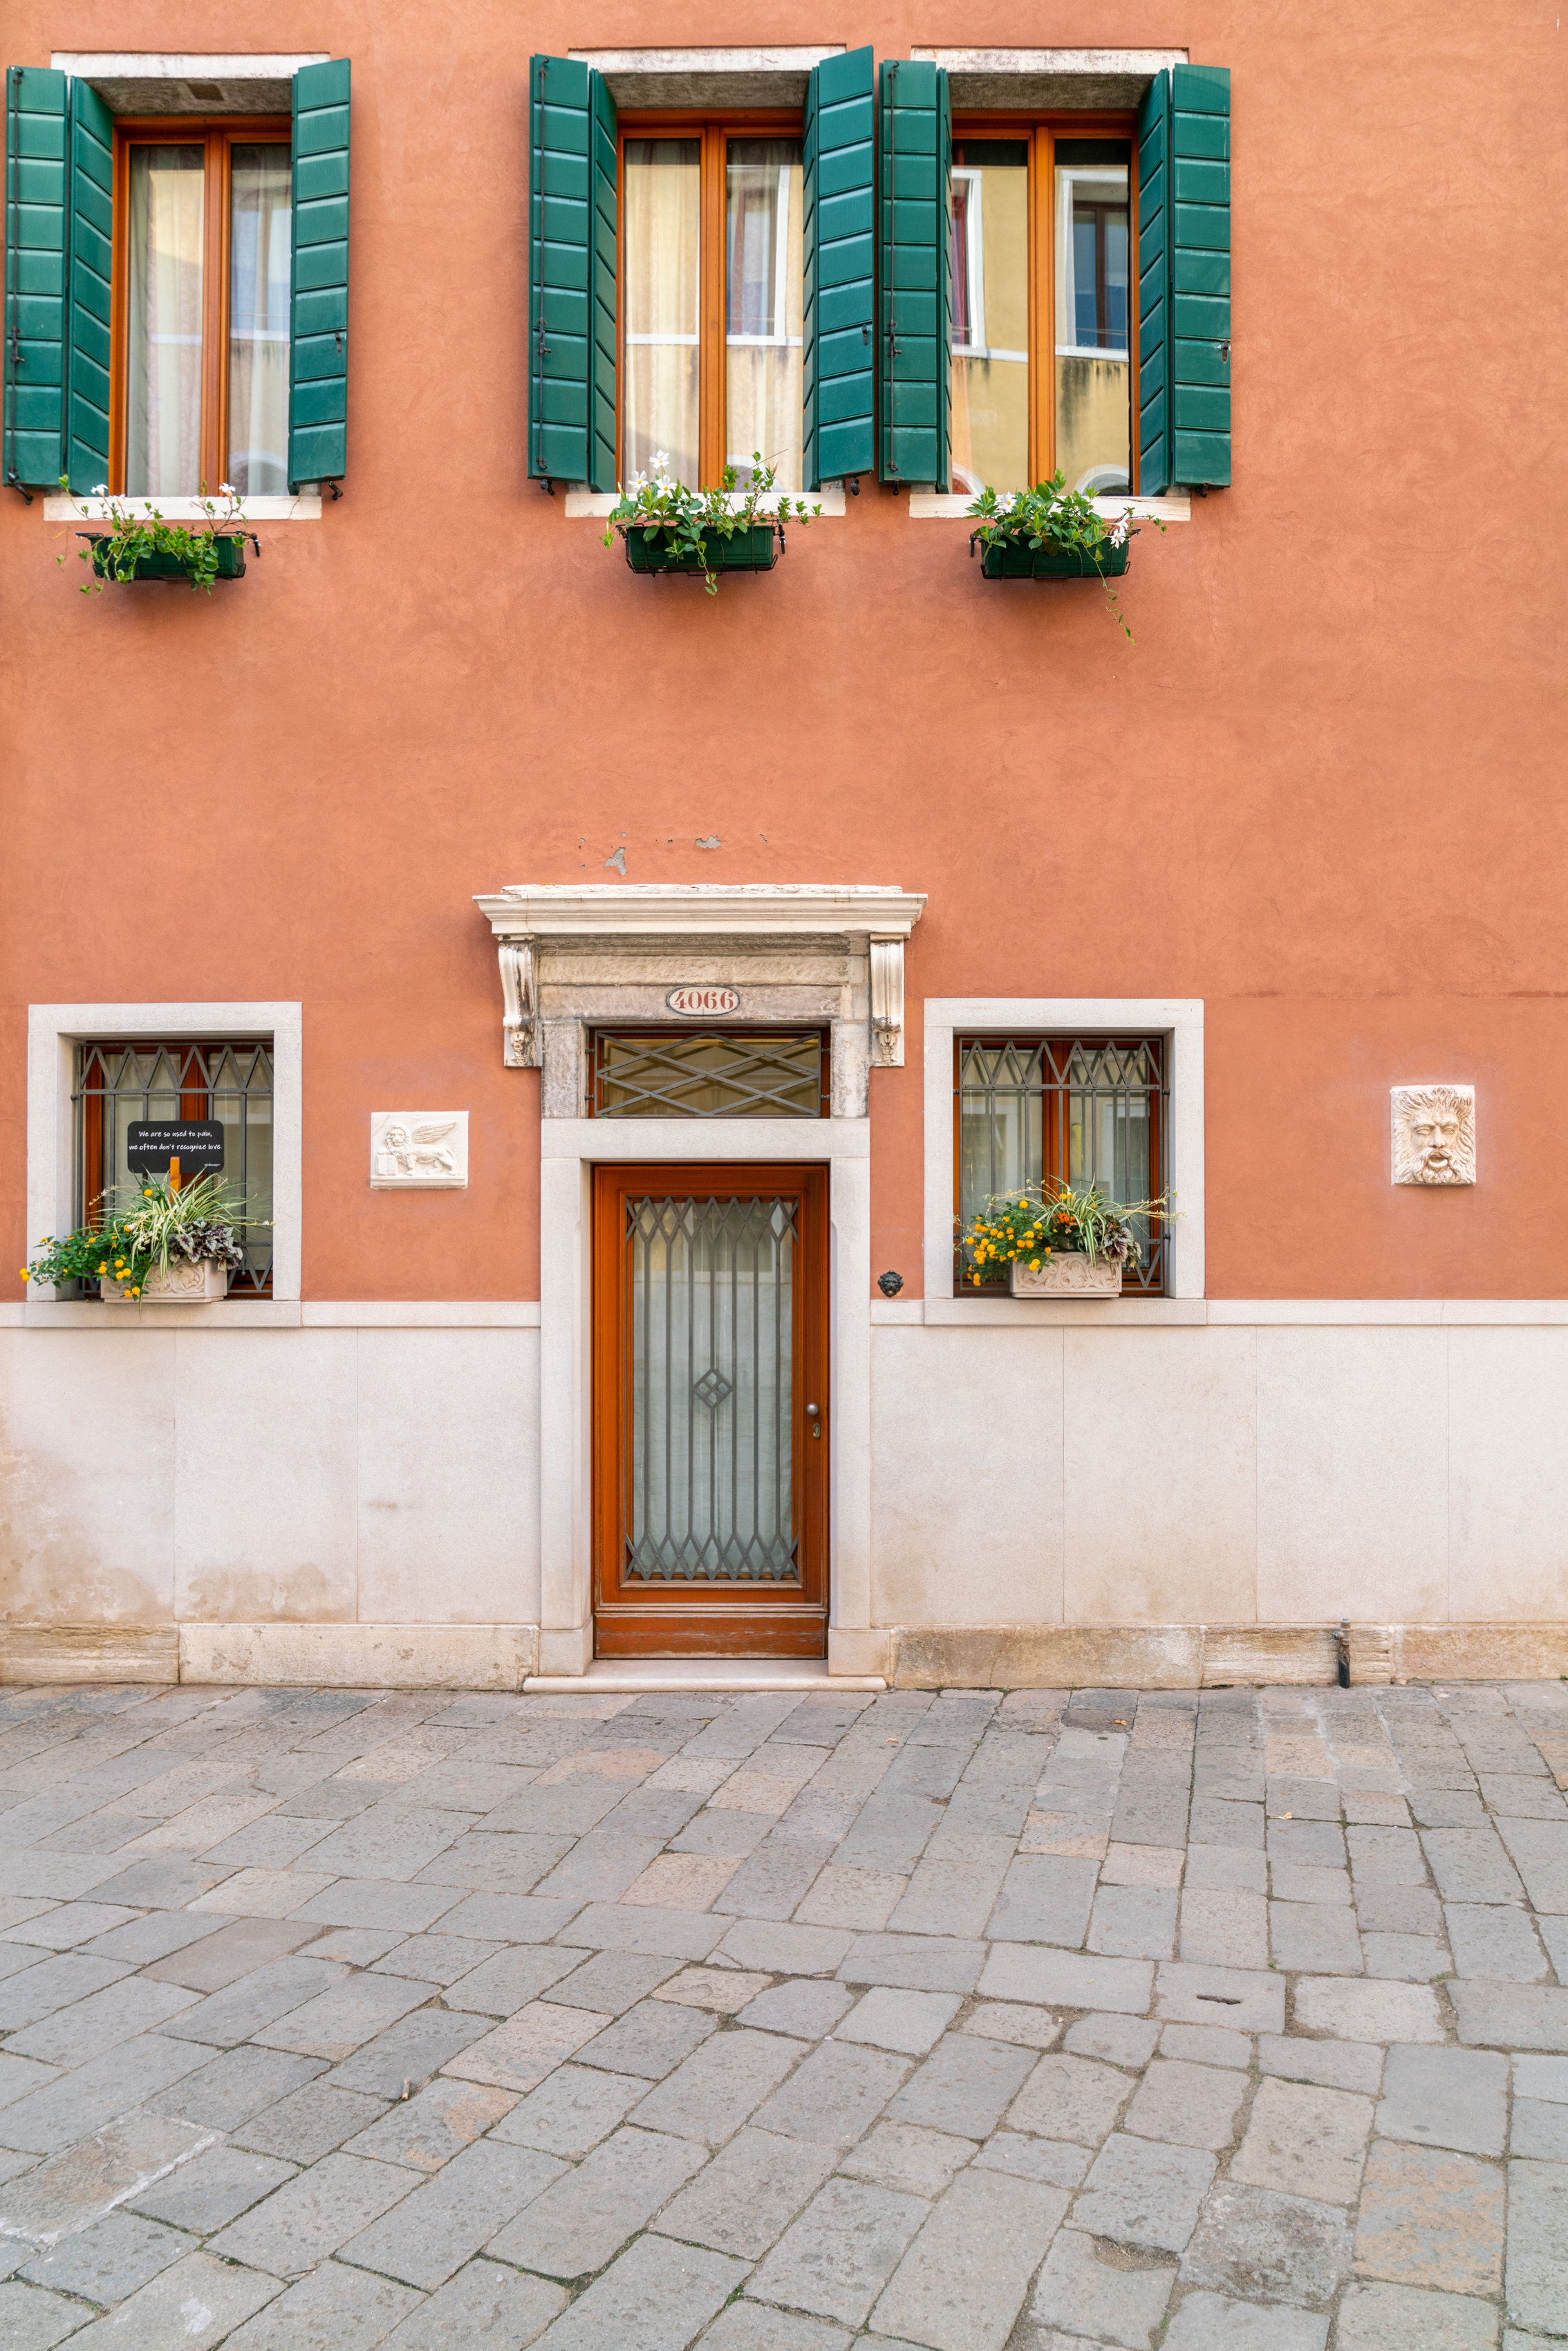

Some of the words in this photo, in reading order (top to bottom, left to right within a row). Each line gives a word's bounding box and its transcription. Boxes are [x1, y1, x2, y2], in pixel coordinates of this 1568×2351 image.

[672, 991, 734, 1010] 4066
[197, 1130, 213, 1138] pain,
[176, 1143, 207, 1153] recognize
